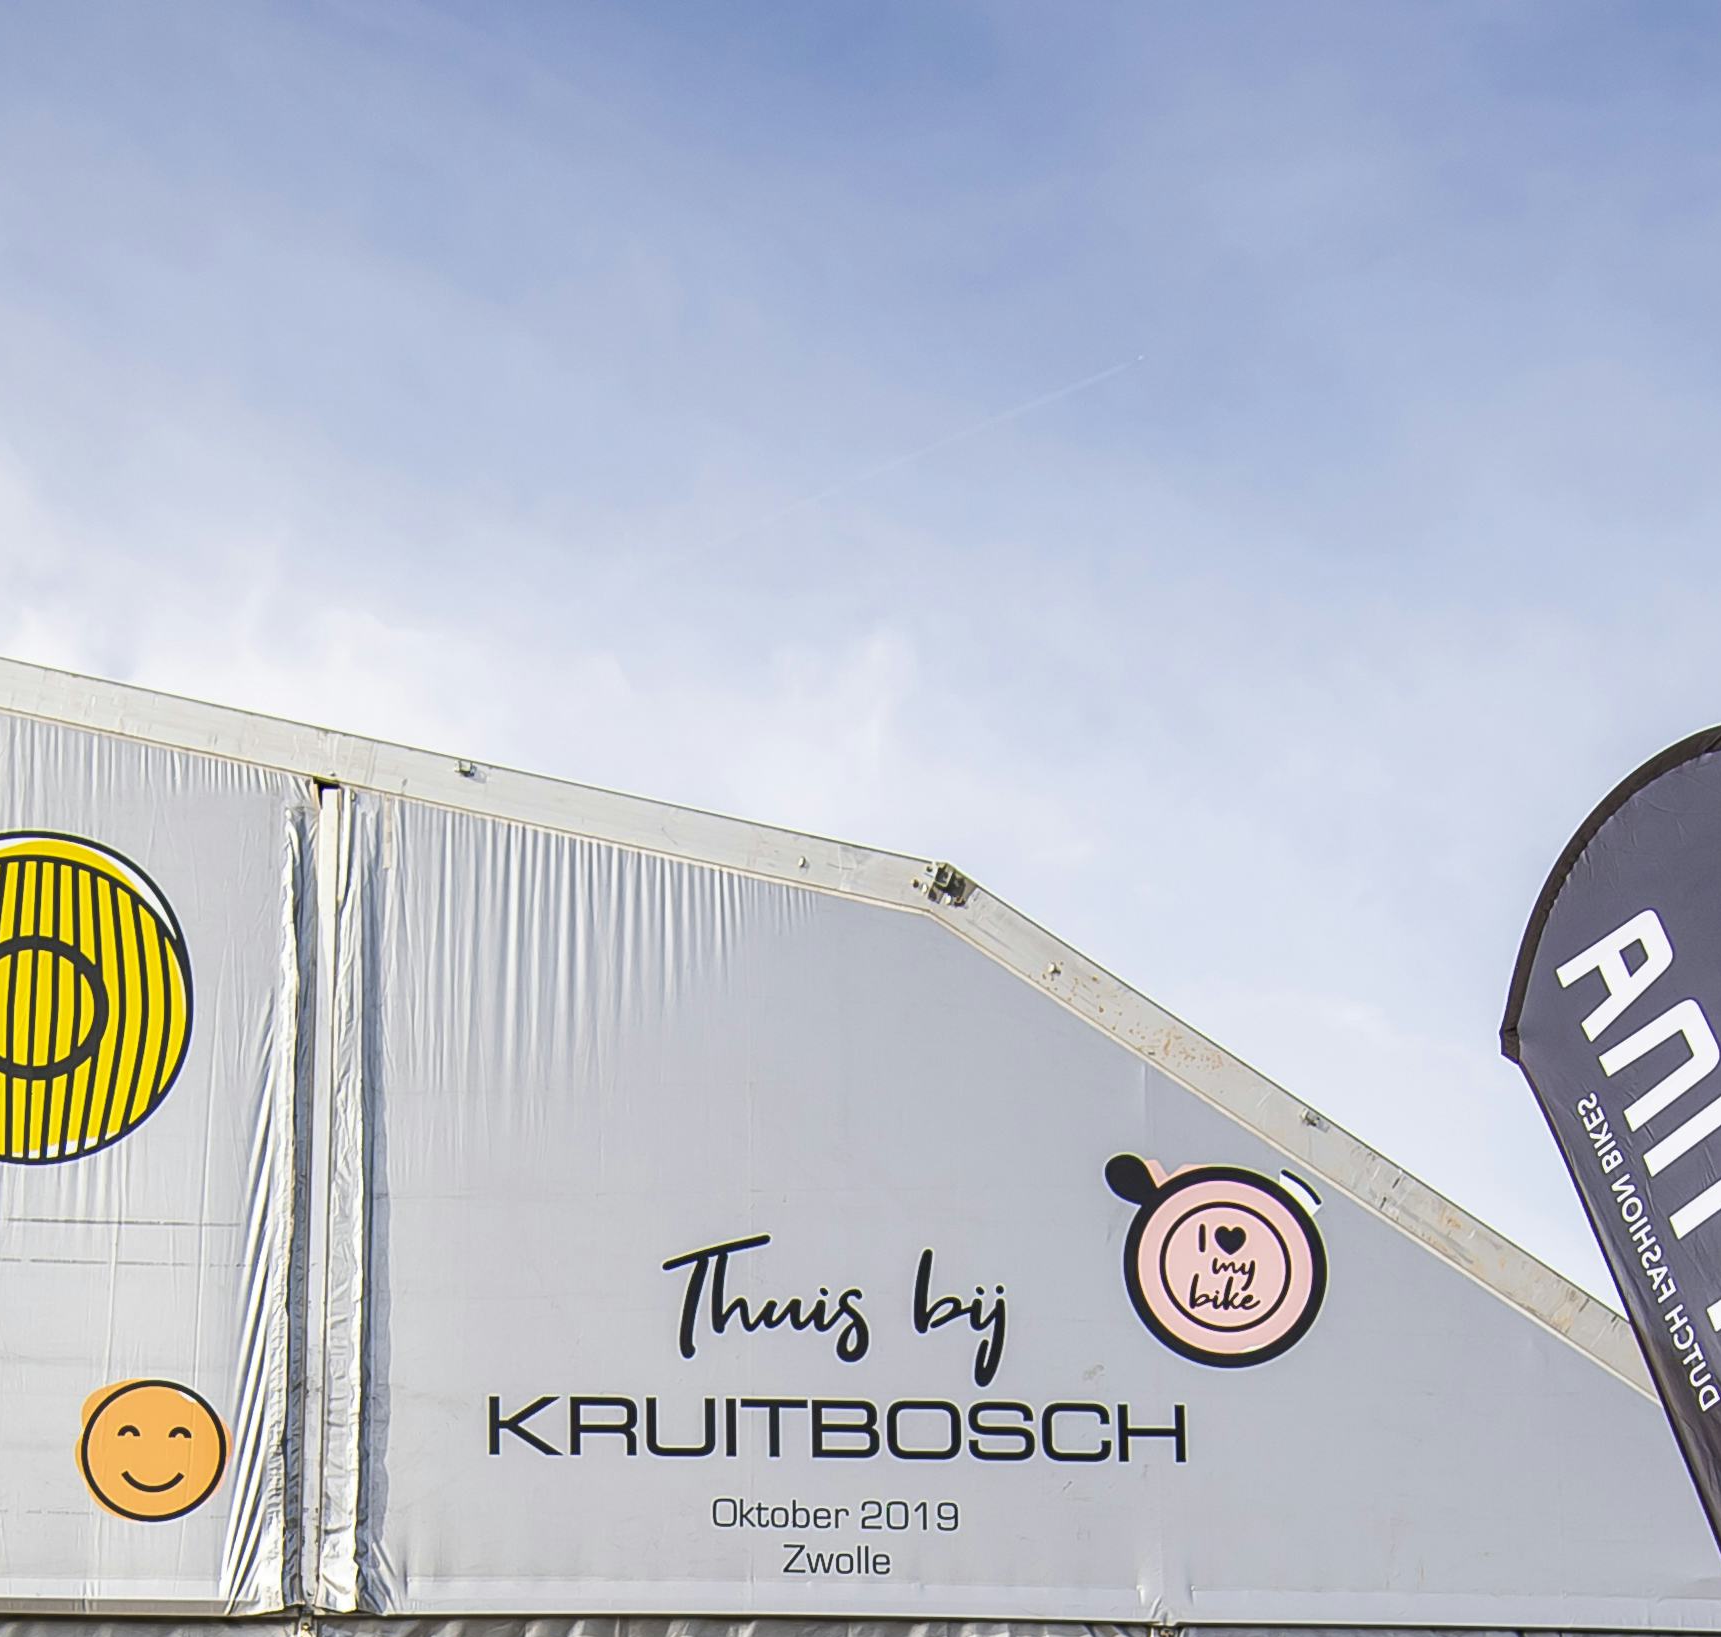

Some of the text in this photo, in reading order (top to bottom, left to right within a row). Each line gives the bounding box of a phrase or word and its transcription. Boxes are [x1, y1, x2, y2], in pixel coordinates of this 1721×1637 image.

[1198, 1223, 1206, 1253] I
[1189, 1272, 1261, 1311] bike
[1212, 1257, 1256, 1292] my
[662, 1234, 1006, 1387] Thuis bij
[488, 1395, 1188, 1464] KRUITBOSCH
[711, 1497, 960, 1533] Oktober 2019
[783, 1543, 892, 1577] Zwolle
